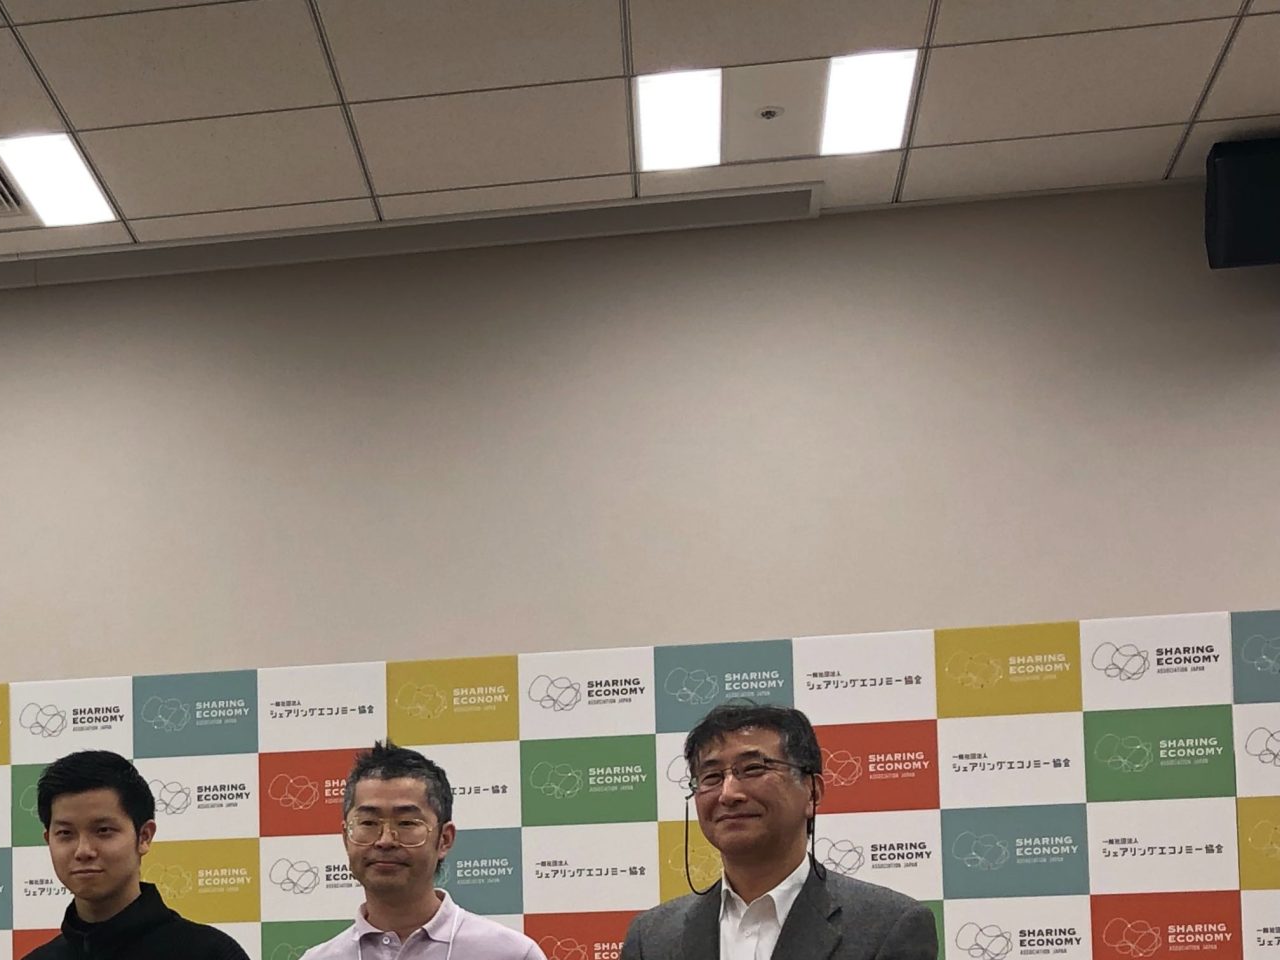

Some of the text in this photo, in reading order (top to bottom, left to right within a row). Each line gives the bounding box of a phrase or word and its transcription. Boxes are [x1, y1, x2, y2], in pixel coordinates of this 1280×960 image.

[1155, 644, 1214, 655] SHARING
[1008, 653, 1065, 664] SHARING
[1156, 654, 1220, 665] ECONOMY
[1008, 663, 1071, 674] ECONOMY
[724, 670, 779, 680] SHARING
[587, 677, 640, 688] SHARING
[725, 679, 784, 690] ECONOMY
[587, 687, 645, 697] ECONOMY
[195, 699, 245, 709] SHARING
[71, 706, 120, 715] SHARING
[195, 708, 249, 717] ECONOMY
[72, 714, 124, 724] ECONOMY
[1158, 737, 1217, 747] SHARING
[868, 751, 924, 761] SHARING
[1159, 747, 1223, 757] ECONOMY
[588, 765, 642, 775] SHARING
[868, 761, 929, 771] ECONOMY
[589, 774, 647, 784] ECONOMY
[196, 783, 246, 792] SHARING
[196, 792, 250, 801] ECONOMY
[1015, 836, 1072, 845] SHARING
[870, 841, 926, 851] SHARING
[1015, 845, 1078, 855] ECONOMY
[870, 851, 931, 861] ECONOMY
[1018, 928, 1076, 937] SHARING
[1167, 923, 1226, 932] SHARING
[1019, 937, 1081, 947] ECONOMY
[1168, 933, 1232, 942] ECONOMY
